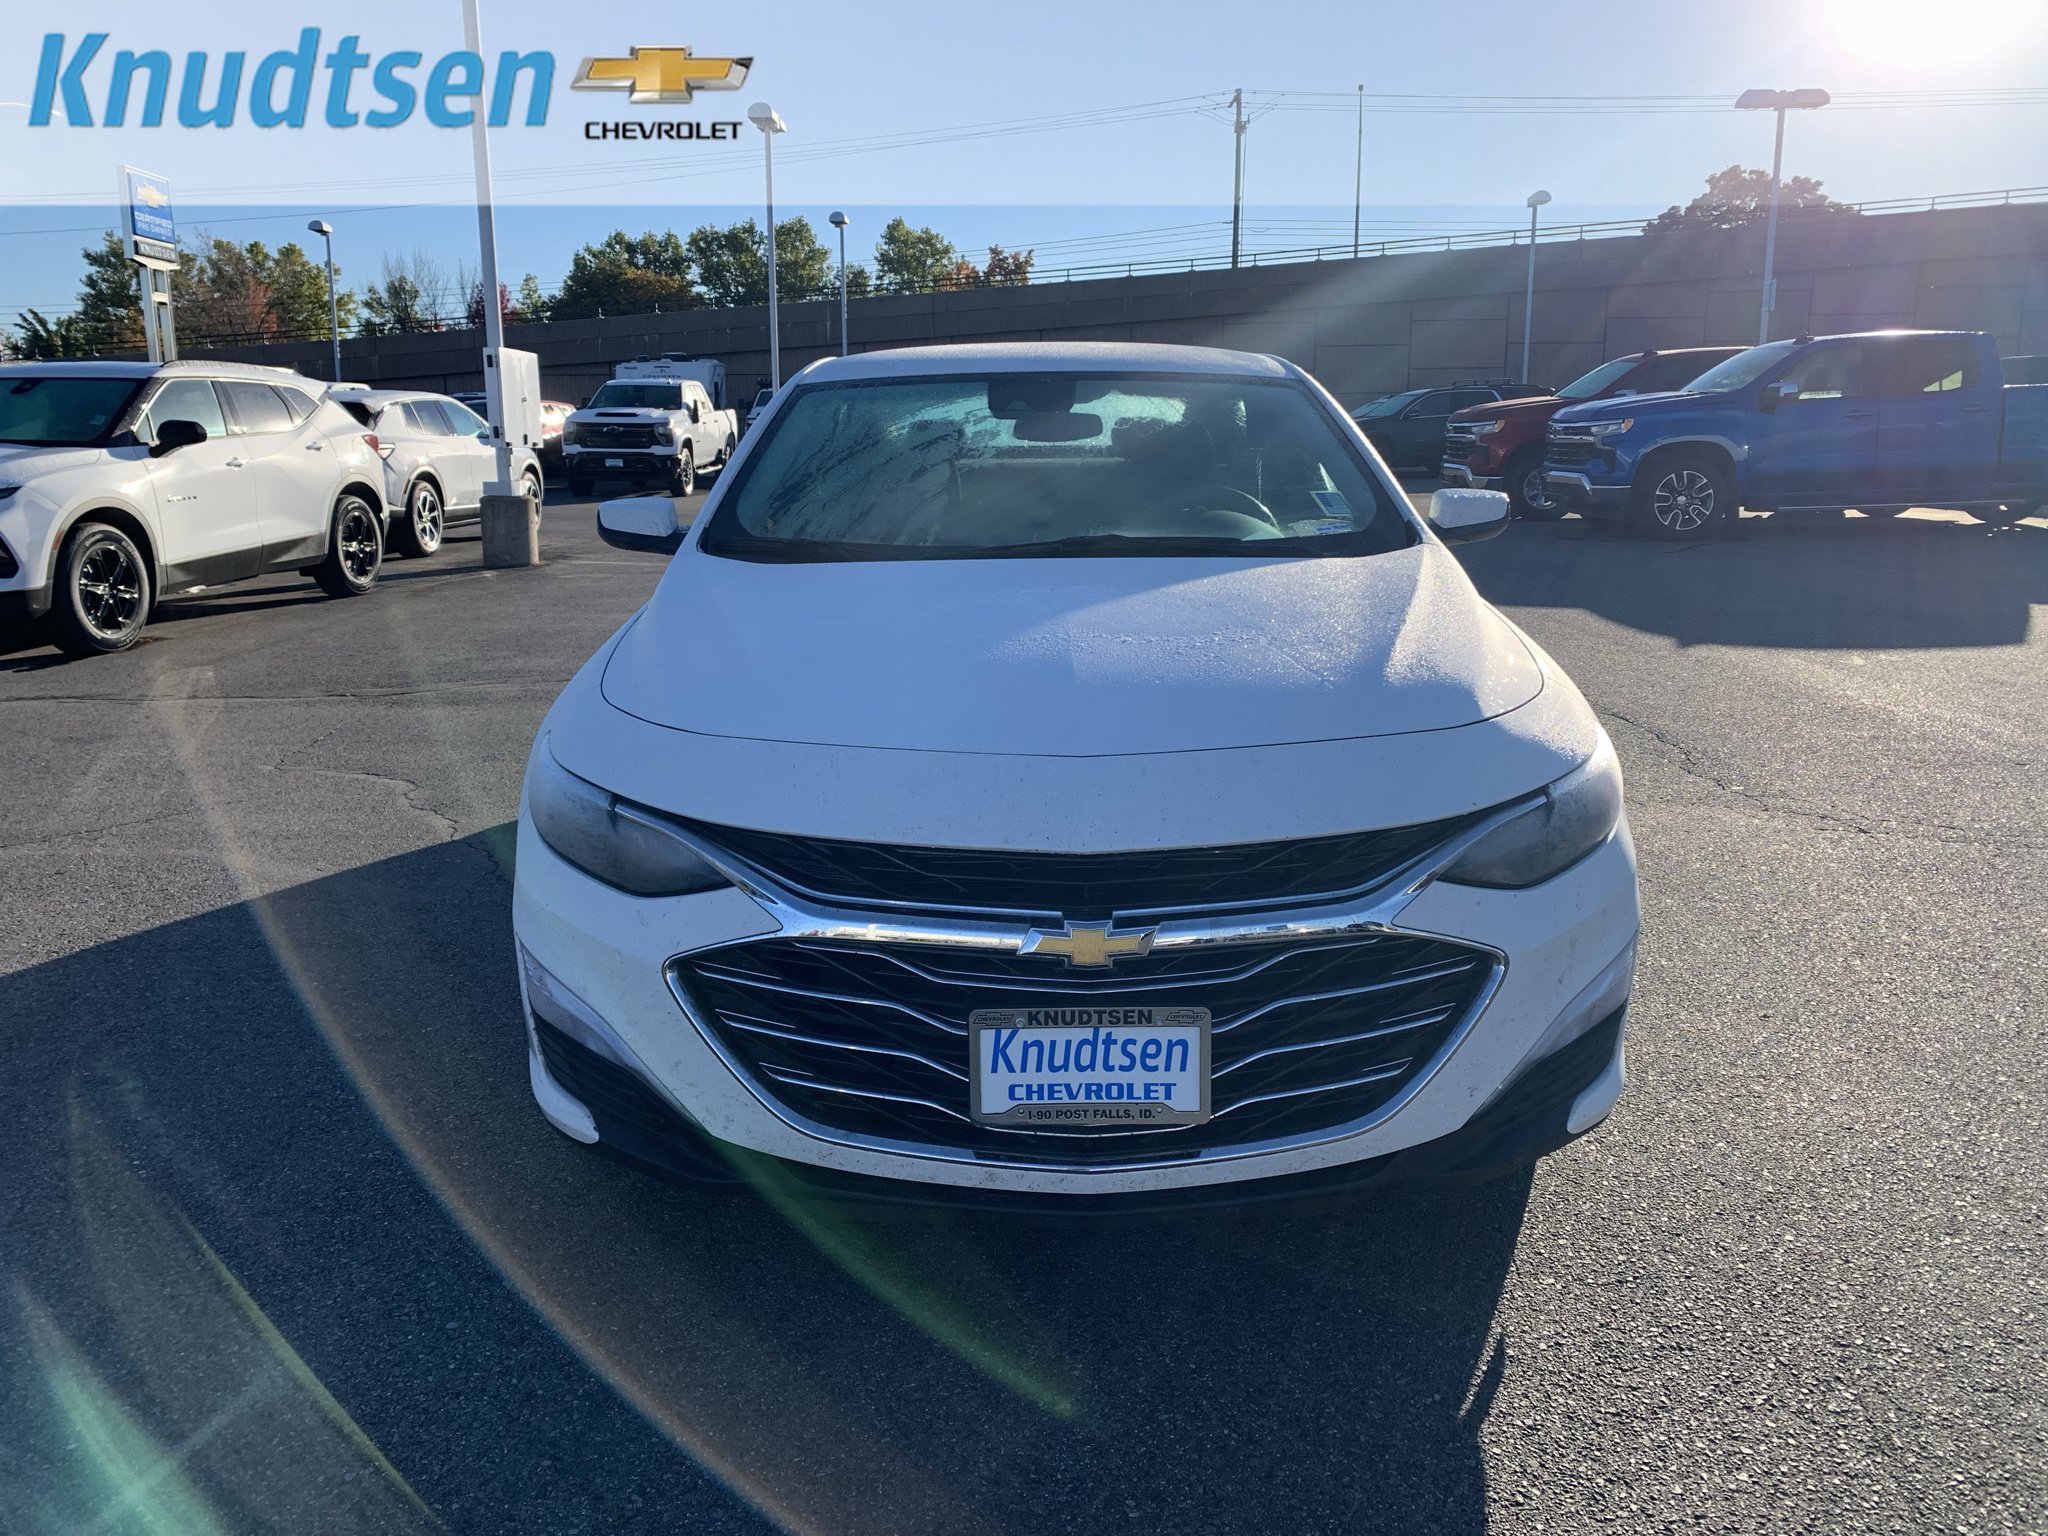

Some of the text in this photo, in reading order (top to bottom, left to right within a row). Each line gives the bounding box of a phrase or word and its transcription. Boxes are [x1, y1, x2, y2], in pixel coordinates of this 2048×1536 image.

[134, 211, 173, 229] CERTIFIED
[140, 244, 176, 260] KNUDTSEN
[1027, 1009, 1153, 1026] KNUDTSEN
[990, 1027, 1189, 1074] Knudtsen
[1008, 1082, 1177, 1101] CHEVROLET
[1028, 1108, 1156, 1120] I-90 POST FALLS, ID.
